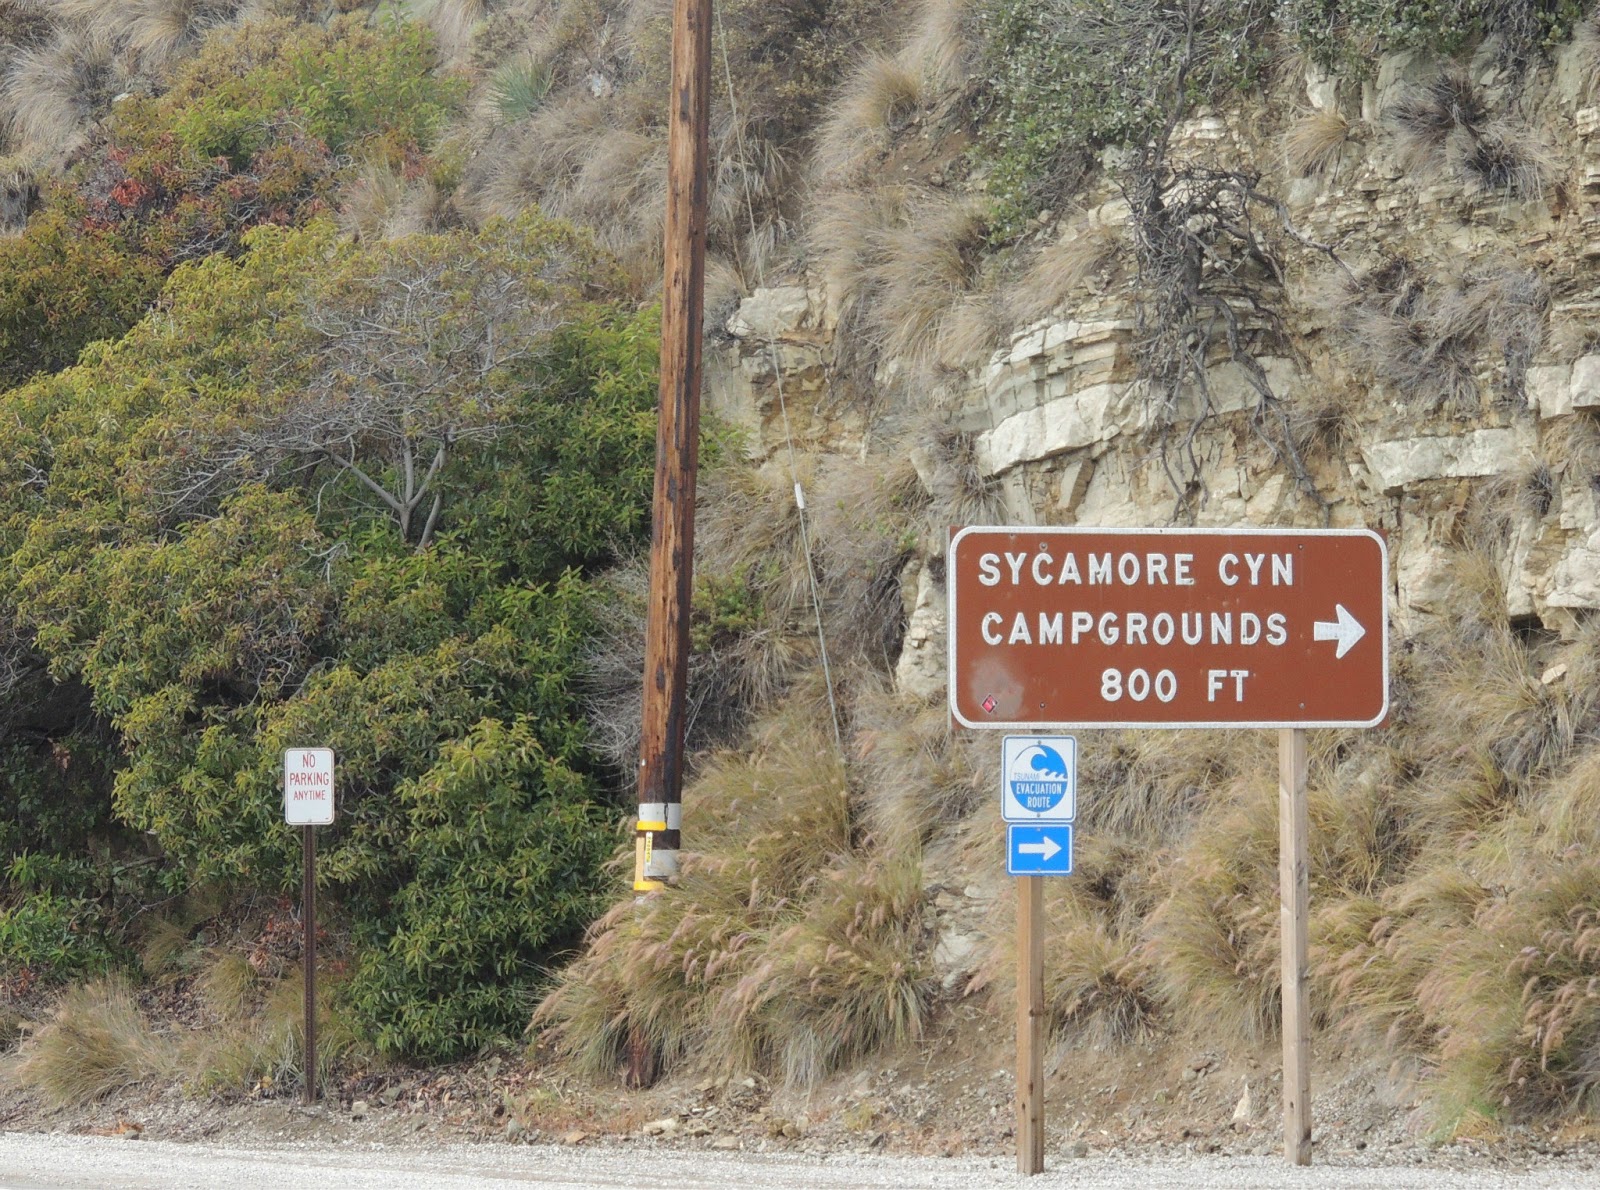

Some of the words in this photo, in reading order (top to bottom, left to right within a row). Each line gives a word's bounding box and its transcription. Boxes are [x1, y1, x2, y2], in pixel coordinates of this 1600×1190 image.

[978, 553, 1194, 586] SYCAMORE
[1219, 553, 1293, 586] CYN
[981, 612, 1288, 646] CAMPGROUNDS
[1100, 668, 1178, 702] 800
[1207, 669, 1249, 702] FT
[303, 754, 315, 768] NO
[290, 772, 329, 786] PARKING
[1013, 772, 1040, 781] TSUNAMI
[293, 790, 326, 801] ANYTIME
[1016, 783, 1062, 794] EVACUATION
[1027, 796, 1051, 808] ROUTE
